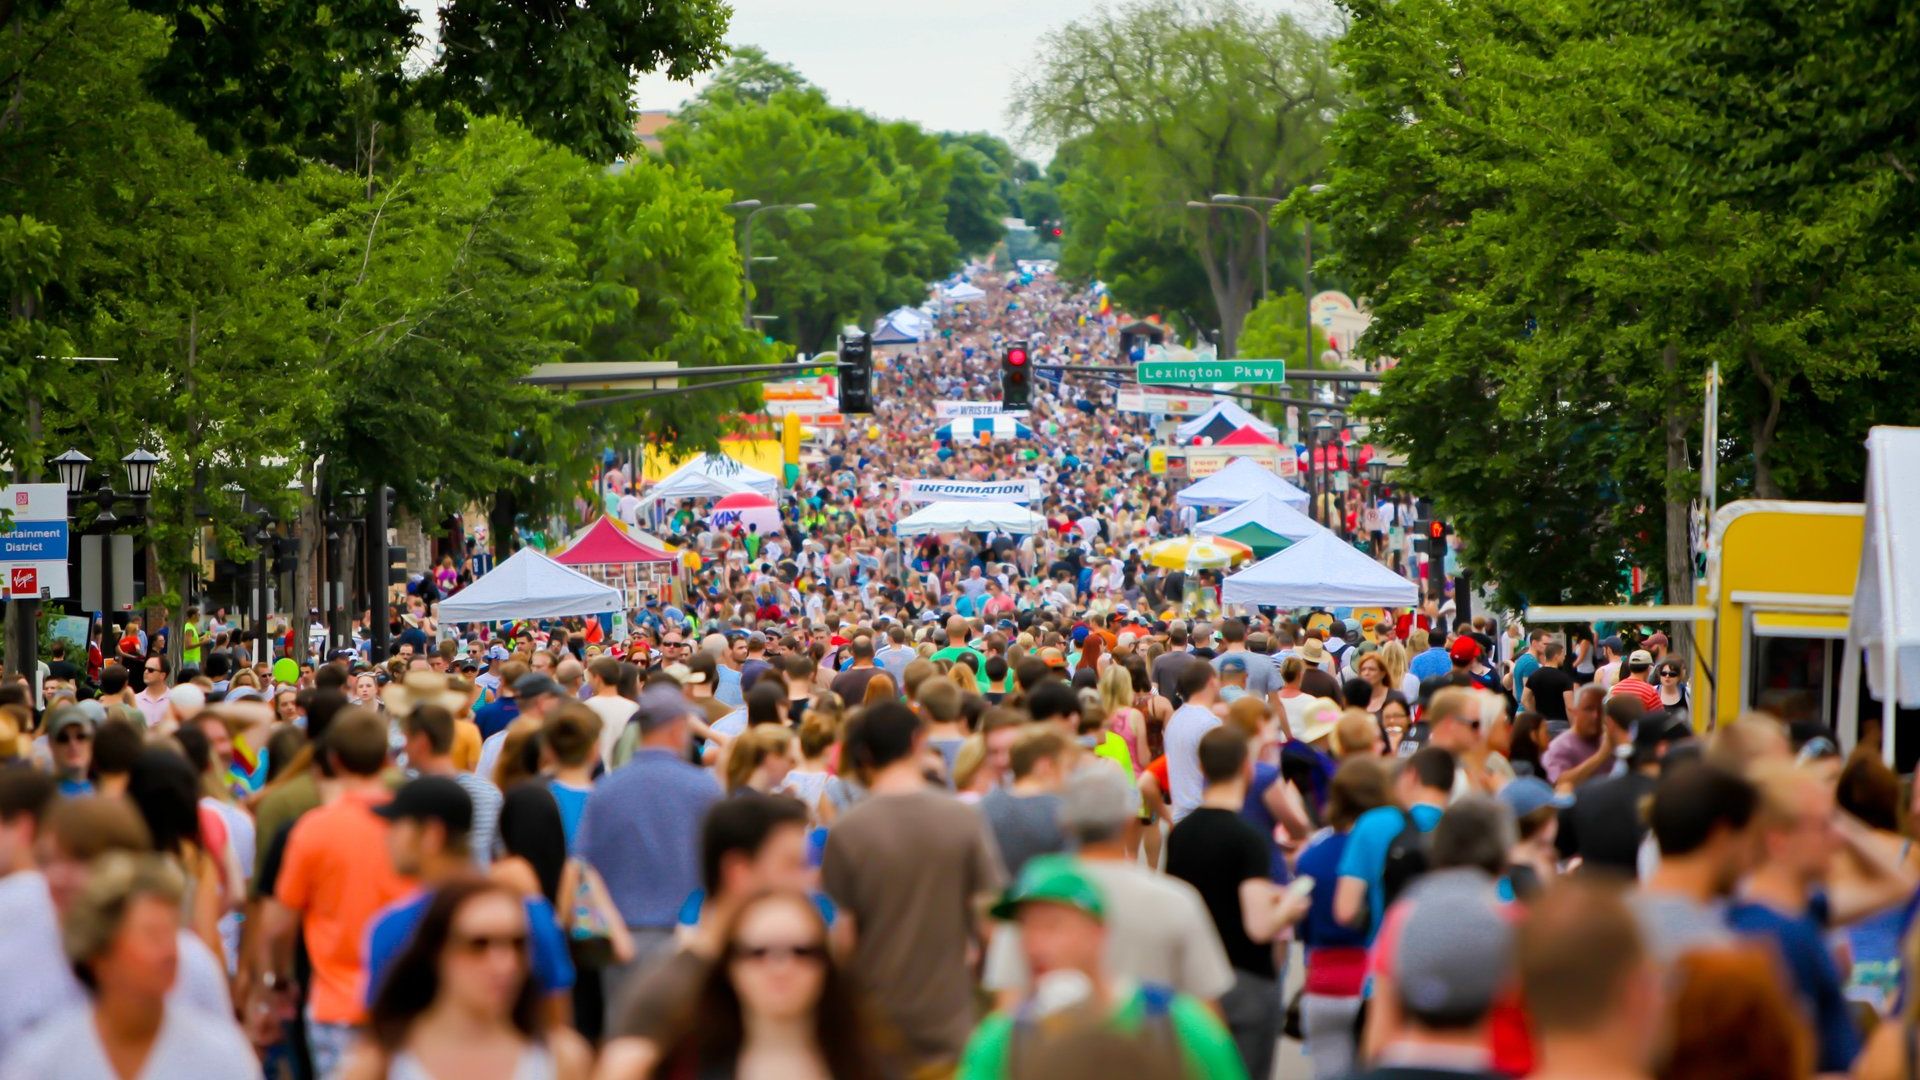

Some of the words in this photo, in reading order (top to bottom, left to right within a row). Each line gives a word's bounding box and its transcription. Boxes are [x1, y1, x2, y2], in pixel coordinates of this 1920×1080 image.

[1145, 367, 1223, 381] Lexington
[1234, 366, 1274, 379] Pkwy
[960, 406, 1015, 415] WRISTBAN
[918, 484, 1024, 494] INFORMATION
[0, 529, 60, 538] ertainment
[5, 542, 43, 551] District
[13, 570, 34, 588] Virgin
